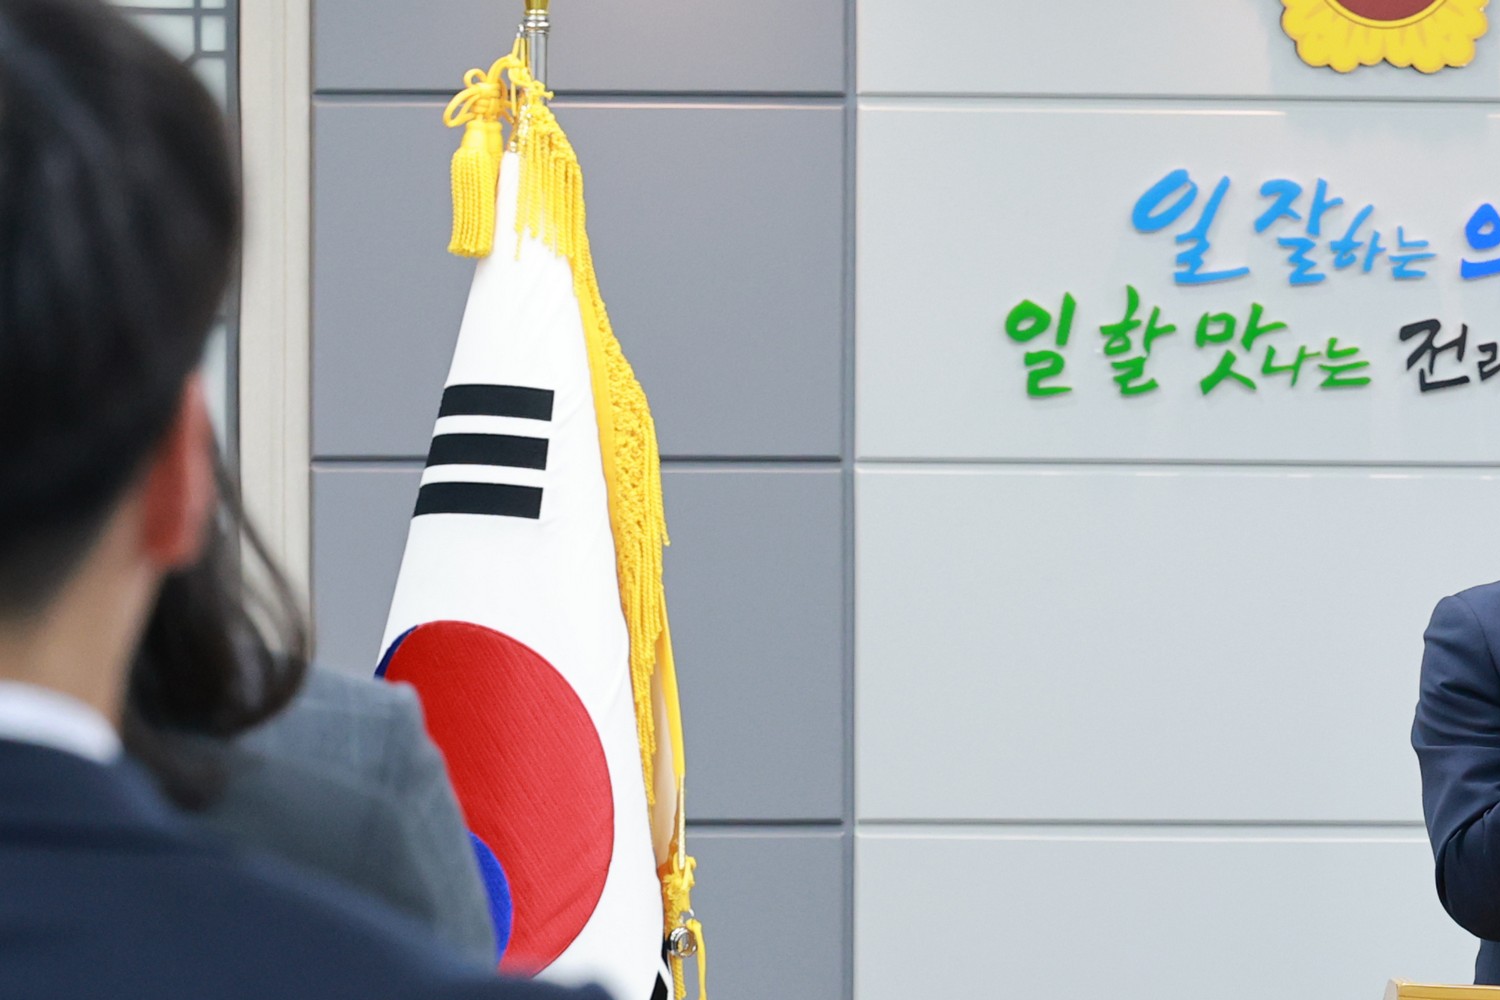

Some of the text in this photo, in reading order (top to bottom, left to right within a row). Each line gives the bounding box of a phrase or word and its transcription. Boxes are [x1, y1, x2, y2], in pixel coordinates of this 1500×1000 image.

[1130, 168, 1251, 286] 일
[1253, 178, 1437, 286] 잘하는
[1005, 292, 1077, 398] 일
[1099, 285, 1177, 397] 할
[1195, 303, 1372, 396] 맛나는
